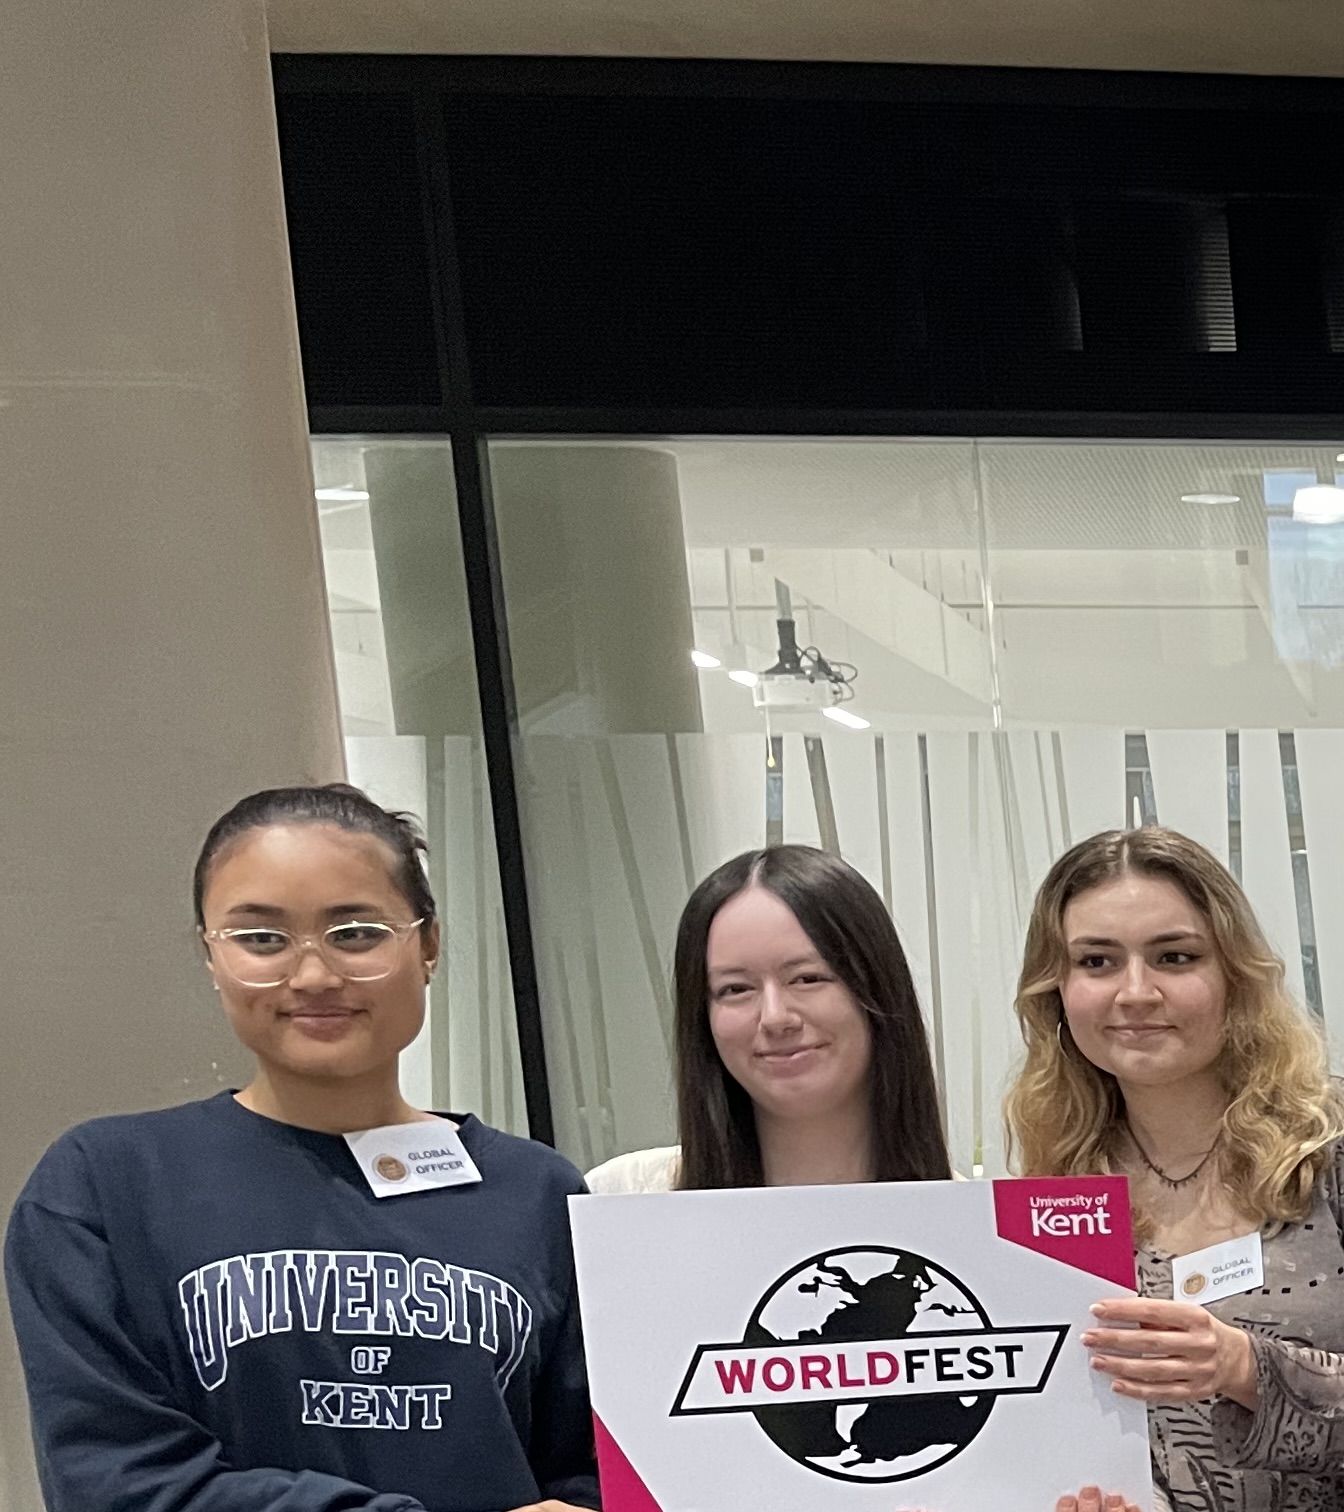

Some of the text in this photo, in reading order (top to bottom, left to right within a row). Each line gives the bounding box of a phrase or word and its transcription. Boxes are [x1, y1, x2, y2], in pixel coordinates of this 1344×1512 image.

[408, 1147, 455, 1161] GLOBAL
[415, 1160, 464, 1175] OFFICER
[1029, 1193, 1109, 1210] University of
[1031, 1206, 1112, 1237] Kent
[1211, 1257, 1251, 1274] GLOBAL
[1212, 1267, 1254, 1286] OFFICER
[178, 1249, 533, 1394] UNIVERSITY
[351, 1346, 391, 1375] OF
[714, 1344, 1025, 1395] WORLDFEST
[300, 1380, 451, 1430] KENT
